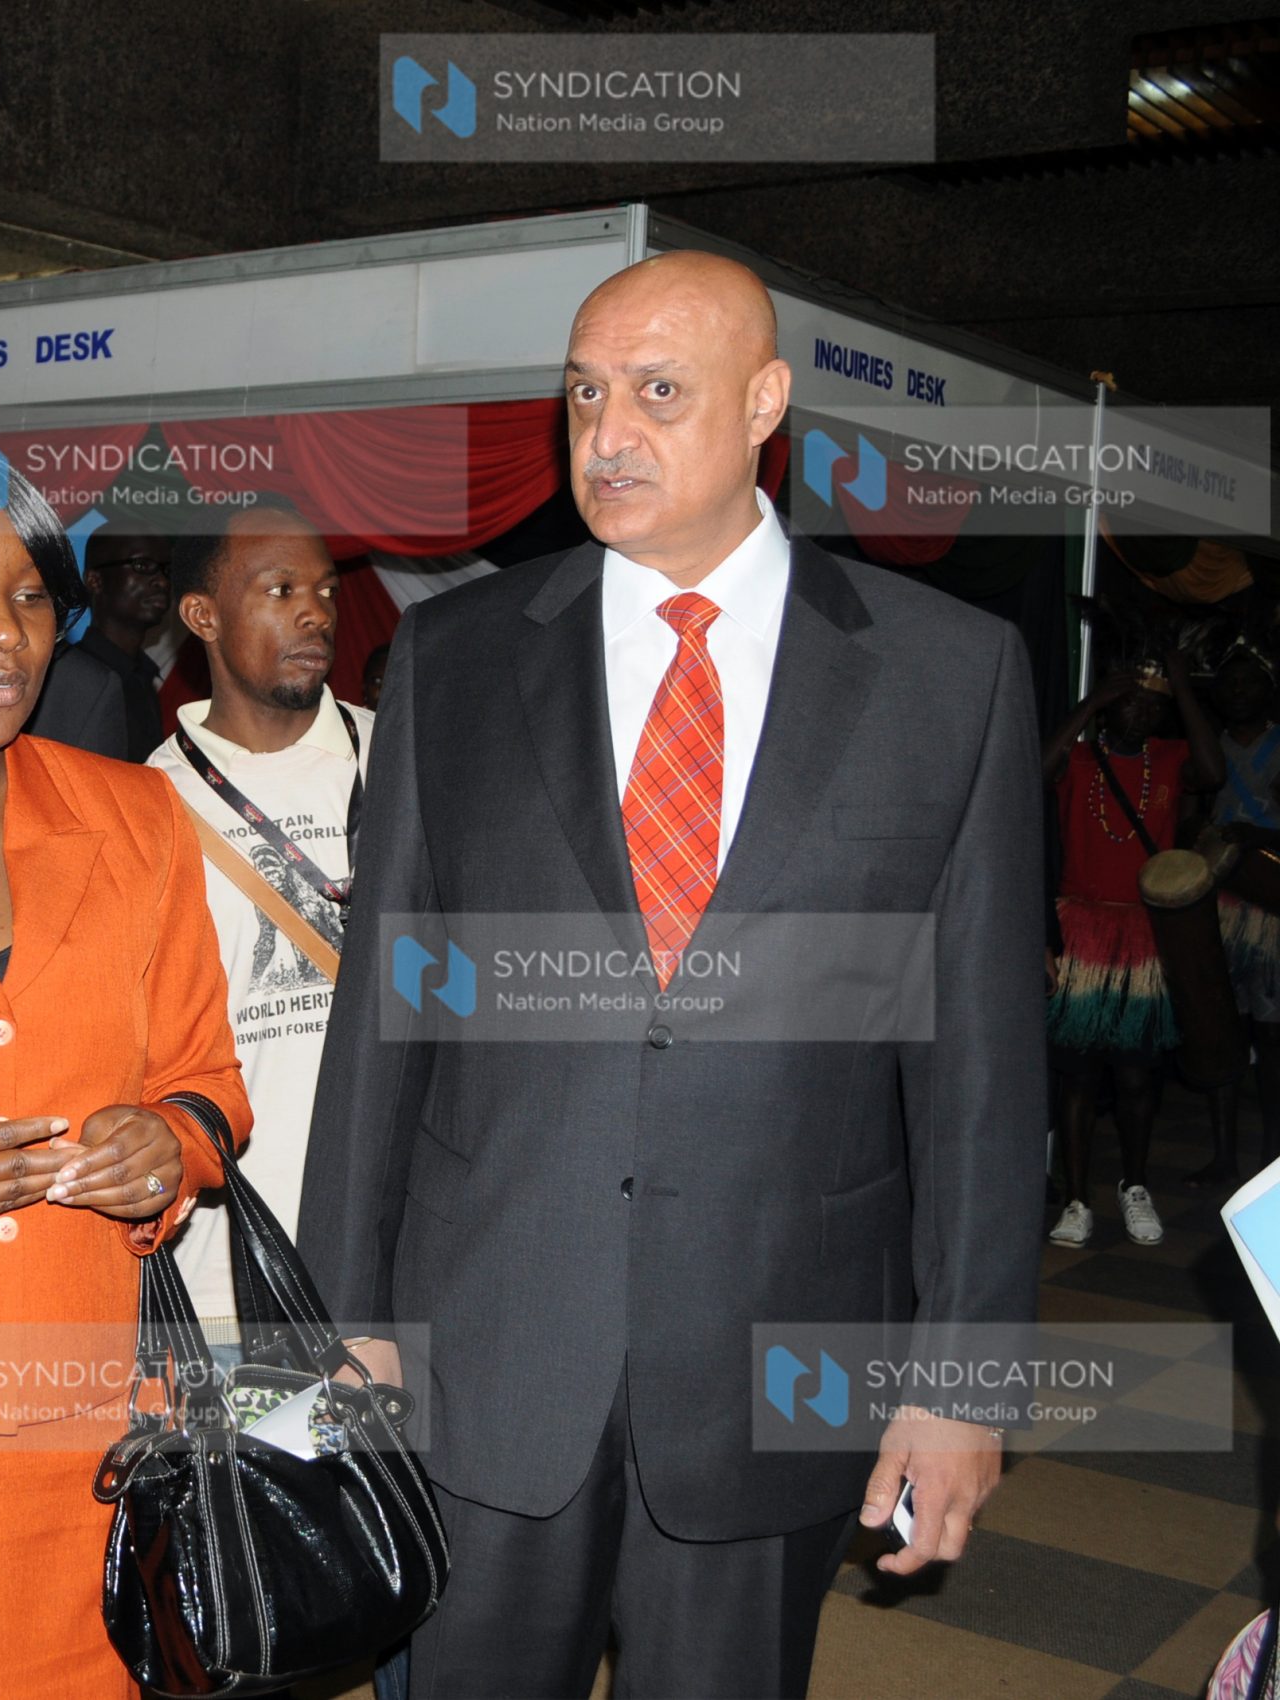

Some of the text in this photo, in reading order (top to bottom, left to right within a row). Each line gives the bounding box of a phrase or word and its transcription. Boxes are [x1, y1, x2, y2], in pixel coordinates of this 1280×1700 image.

[35, 328, 115, 363] DESK
[814, 338, 946, 406] INQUIRIES DESK
[223, 814, 314, 840] MOUTAIN
[290, 825, 348, 842] GORILL
[236, 999, 286, 1025] WORLD
[236, 1020, 328, 1045] BWINDI FORE
